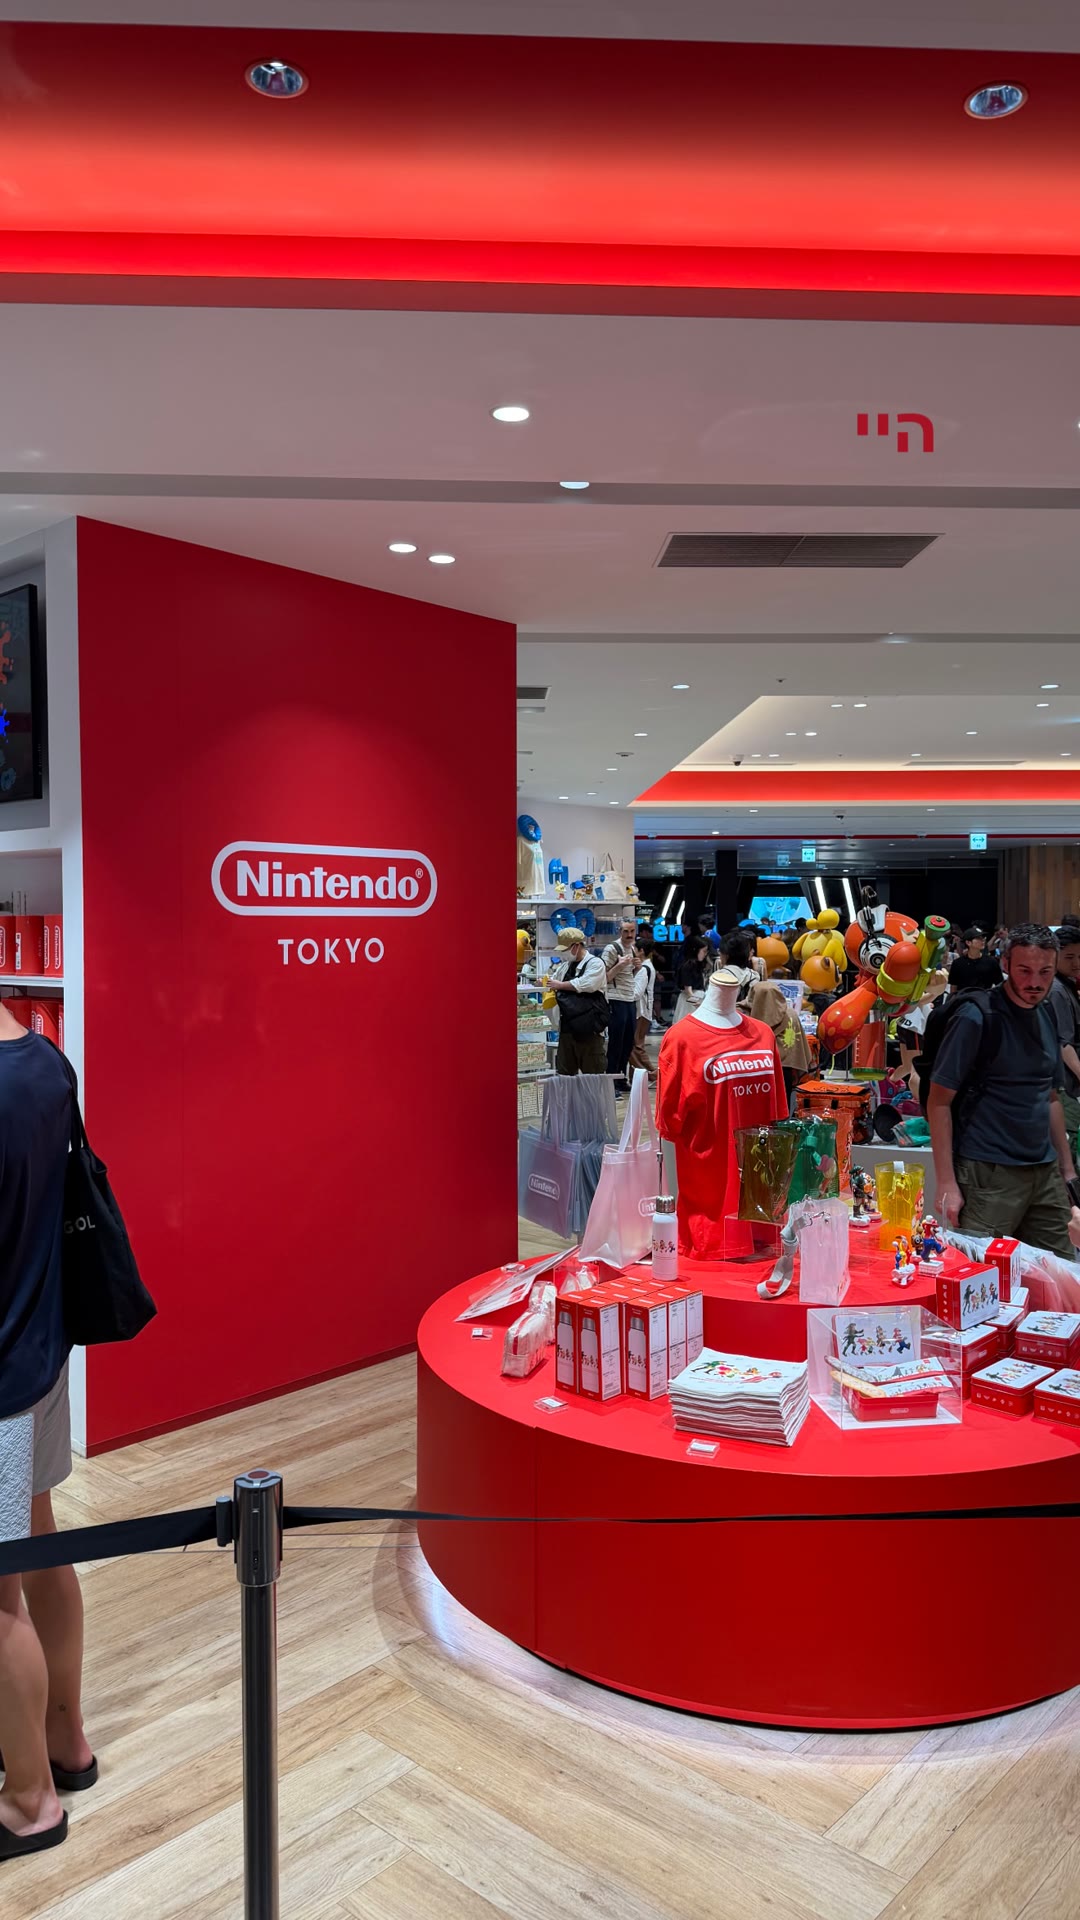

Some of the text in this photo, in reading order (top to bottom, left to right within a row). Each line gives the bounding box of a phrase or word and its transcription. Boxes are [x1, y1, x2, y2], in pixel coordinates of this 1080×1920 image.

[277, 937, 385, 966] TOKYO
[710, 1055, 774, 1078] Nintend
[733, 1082, 771, 1098] TOKYO
